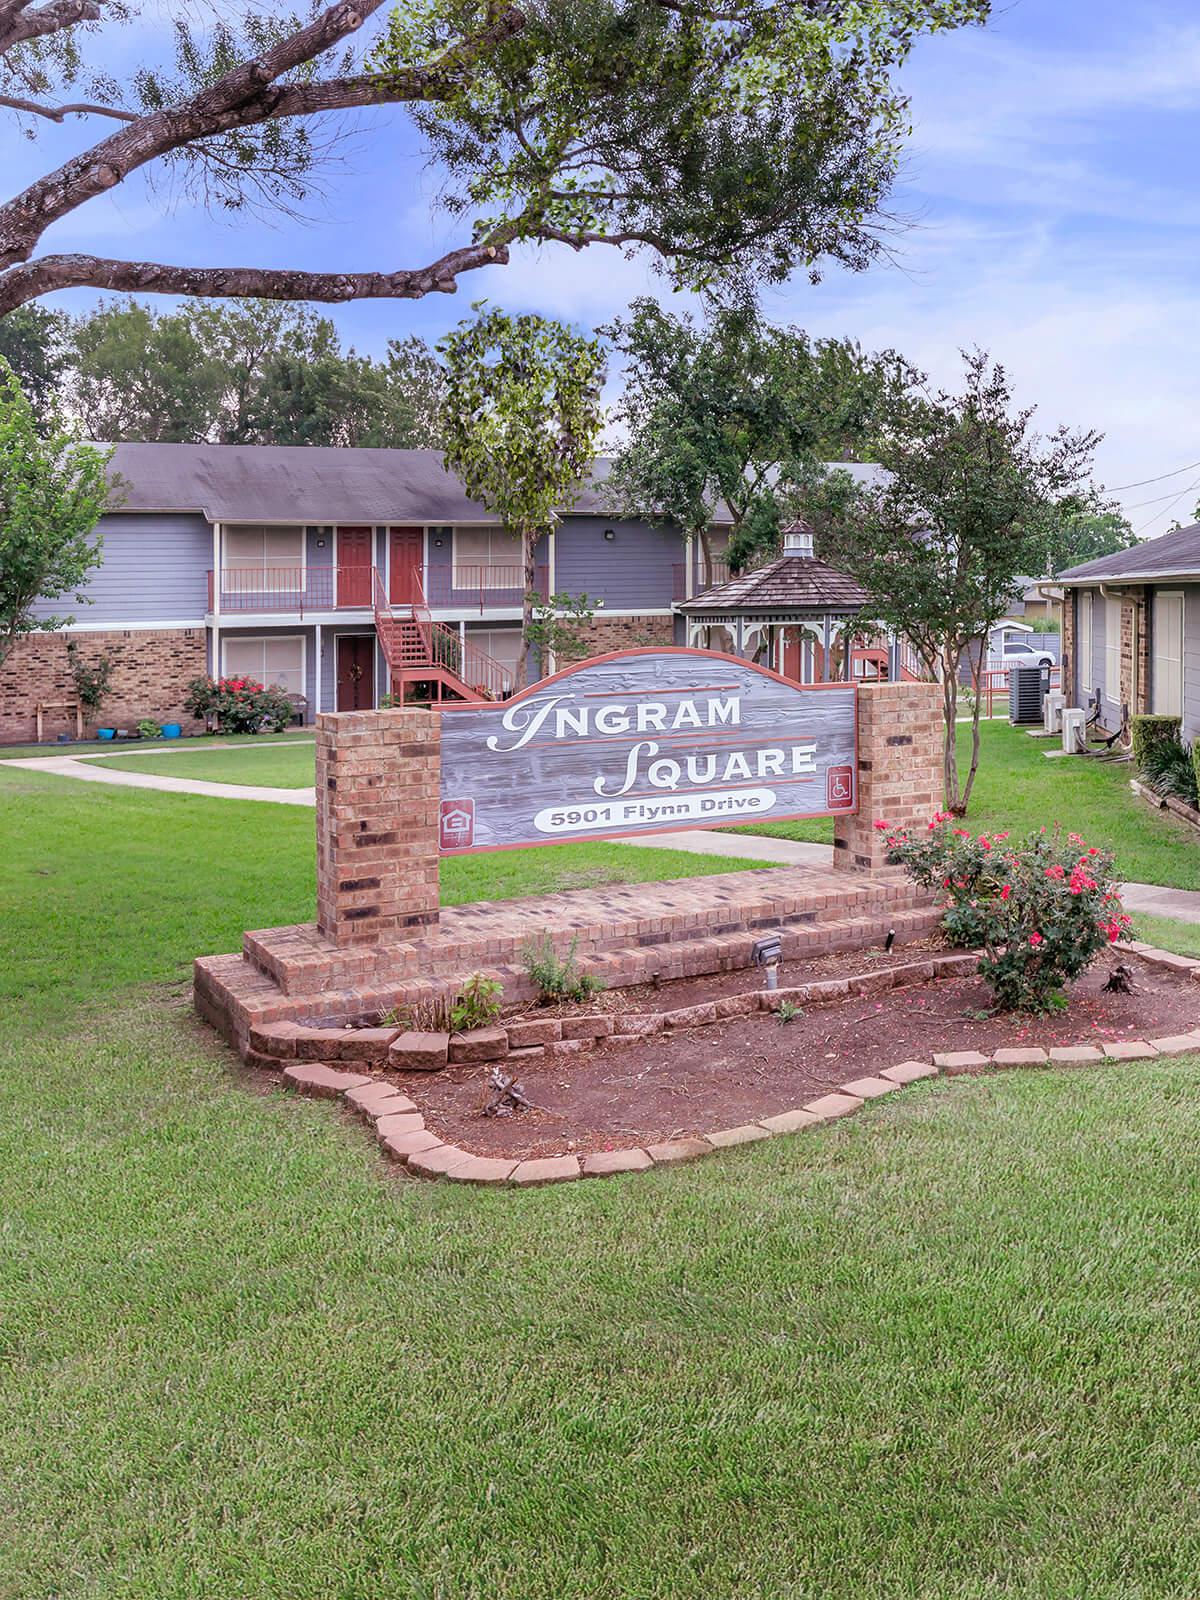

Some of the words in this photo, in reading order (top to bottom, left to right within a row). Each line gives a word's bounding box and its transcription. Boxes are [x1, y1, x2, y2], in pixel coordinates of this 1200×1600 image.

[487, 694, 741, 752] INGRAM
[594, 742, 817, 797] SQUARE
[550, 807, 611, 826] 5901
[623, 803, 690, 820] Flynn
[701, 797, 761, 811] Drive
